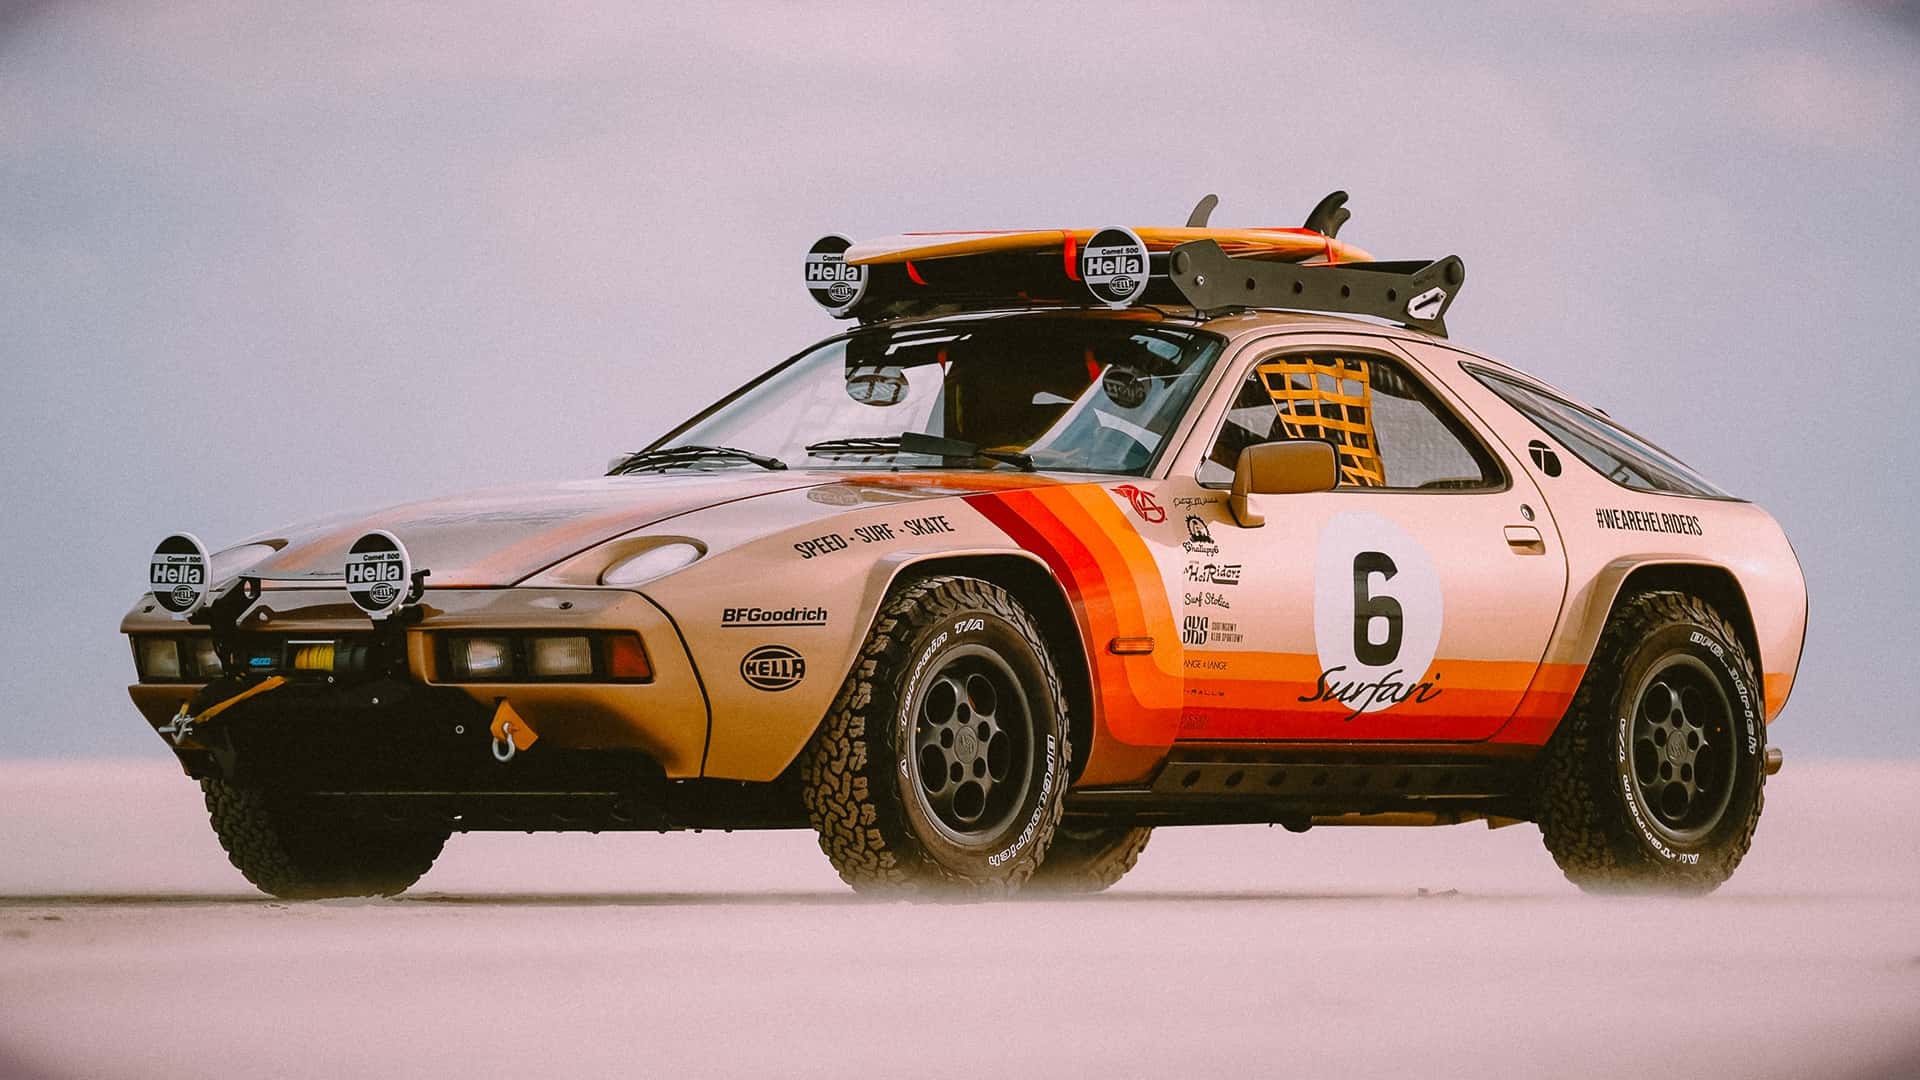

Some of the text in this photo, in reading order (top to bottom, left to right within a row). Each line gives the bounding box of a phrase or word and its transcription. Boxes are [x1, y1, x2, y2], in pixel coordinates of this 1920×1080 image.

[808, 263, 858, 280] Hella
[1086, 256, 1140, 275] Hella
[1596, 508, 1703, 536] #WEAREHELRIDERS
[793, 515, 956, 560] SPEED SURF SKATE
[153, 564, 201, 583] Hella
[348, 562, 400, 582] Hella
[1184, 591, 1203, 608] Surf
[1353, 551, 1403, 667] 6
[722, 607, 828, 622] BFGoodrich
[954, 618, 985, 634] T/A
[745, 658, 805, 680] HELLA
[1297, 665, 1442, 721] Surfari
